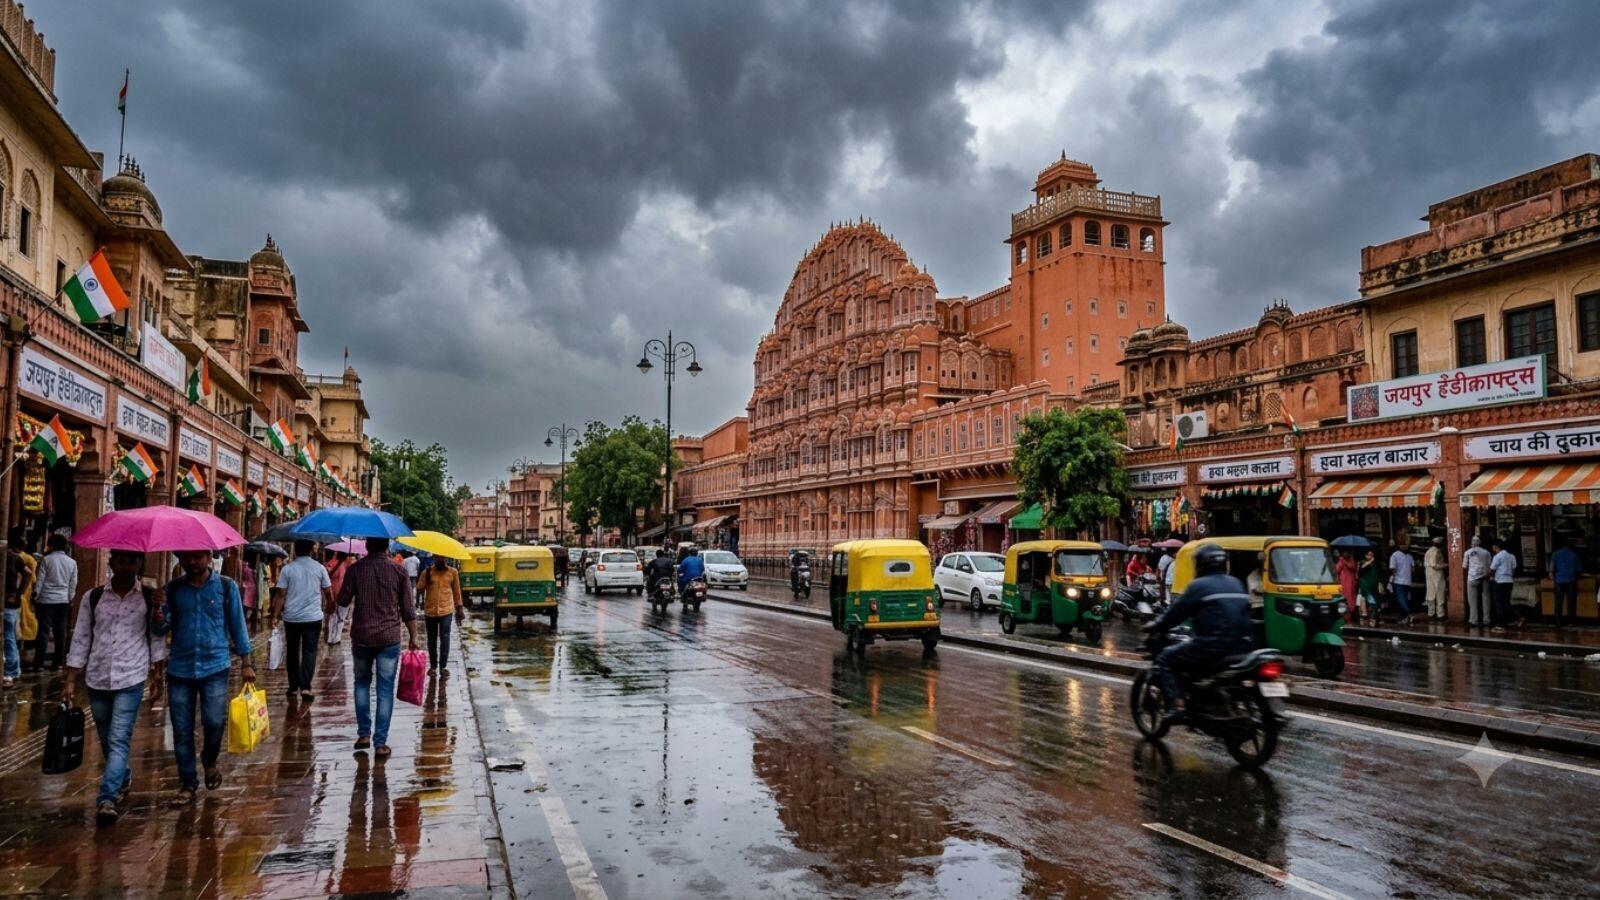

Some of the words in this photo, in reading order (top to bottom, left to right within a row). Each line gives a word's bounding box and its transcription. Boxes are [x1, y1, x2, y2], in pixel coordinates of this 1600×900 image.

[1384, 383, 1432, 406] जयपुर
[1489, 438, 1522, 453] चाय
[1527, 431, 1550, 451] की
[1556, 431, 1600, 454] दुका
[1320, 455, 1344, 470] हवा
[1347, 451, 1381, 468] महल
[1385, 446, 1428, 463] बाजार
